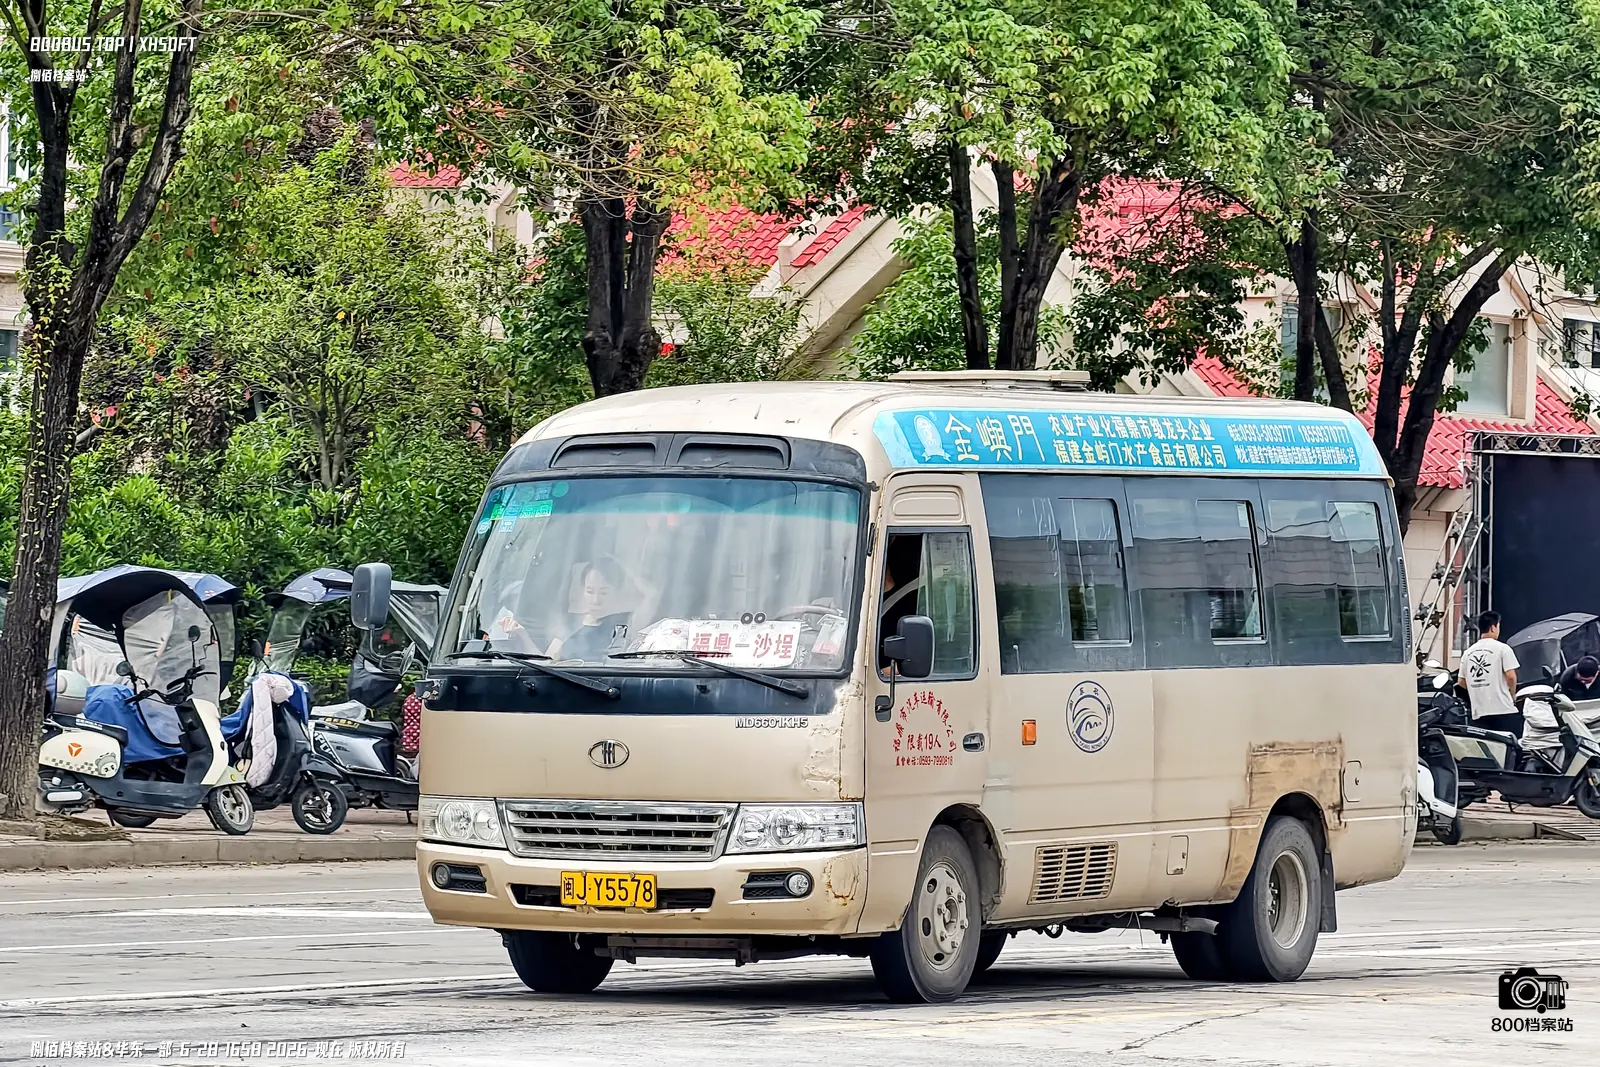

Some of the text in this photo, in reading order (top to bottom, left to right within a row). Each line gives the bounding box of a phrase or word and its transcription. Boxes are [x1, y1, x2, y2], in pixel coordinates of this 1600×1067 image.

[1047, 413, 1215, 441] 农业产业化福鼎市级龙头企业
[1053, 439, 1227, 468] 福建金屿门水产食品有限公司
[735, 717, 809, 729] MD6601KH5
